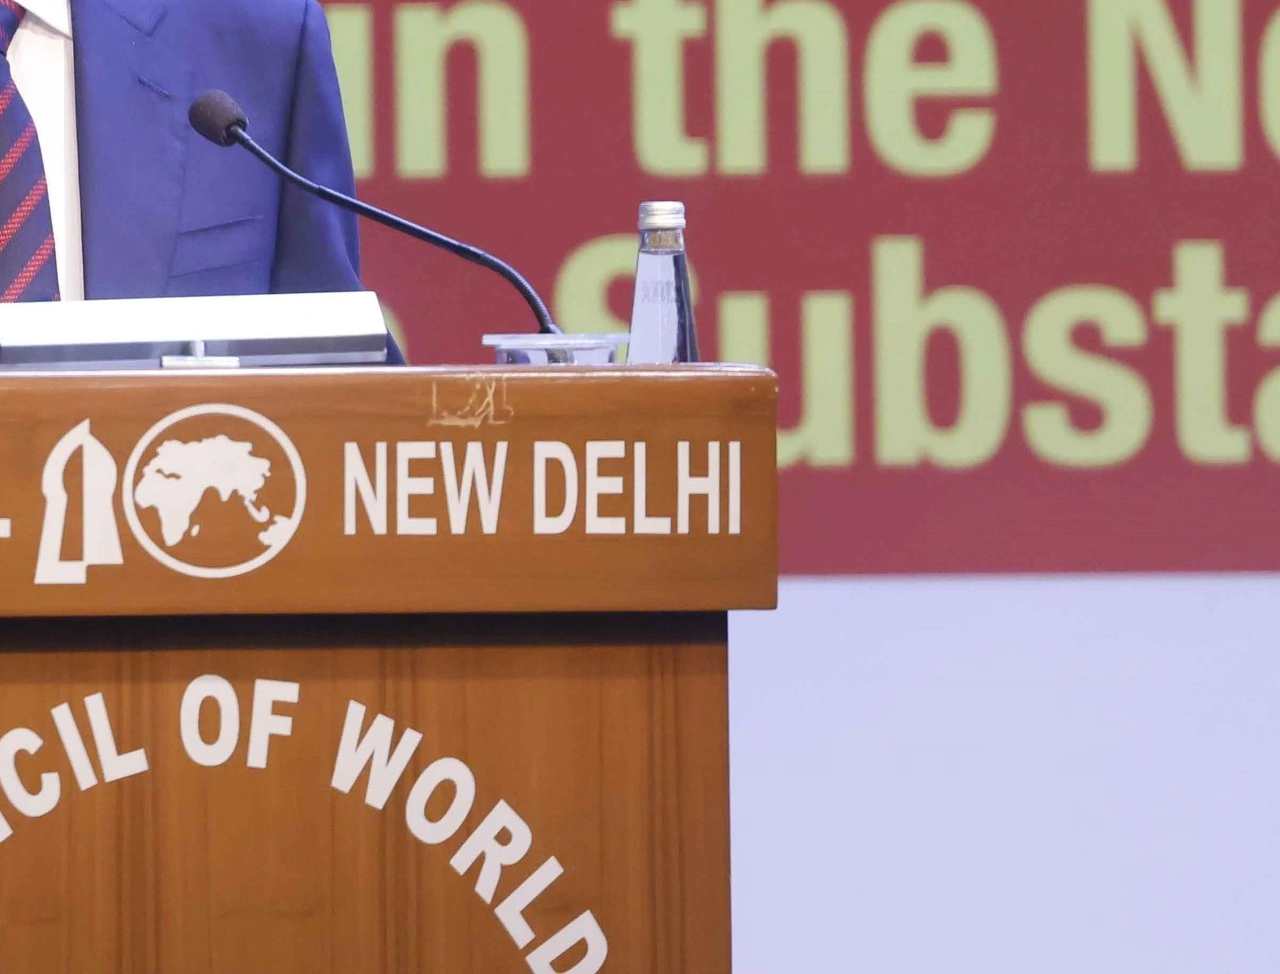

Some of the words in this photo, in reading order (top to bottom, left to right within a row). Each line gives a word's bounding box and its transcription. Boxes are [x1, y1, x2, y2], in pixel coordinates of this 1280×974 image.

[343, 441, 507, 536] NEW
[533, 439, 742, 534] DELHI
[179, 674, 300, 769] OF
[330, 700, 608, 974] WORLD
